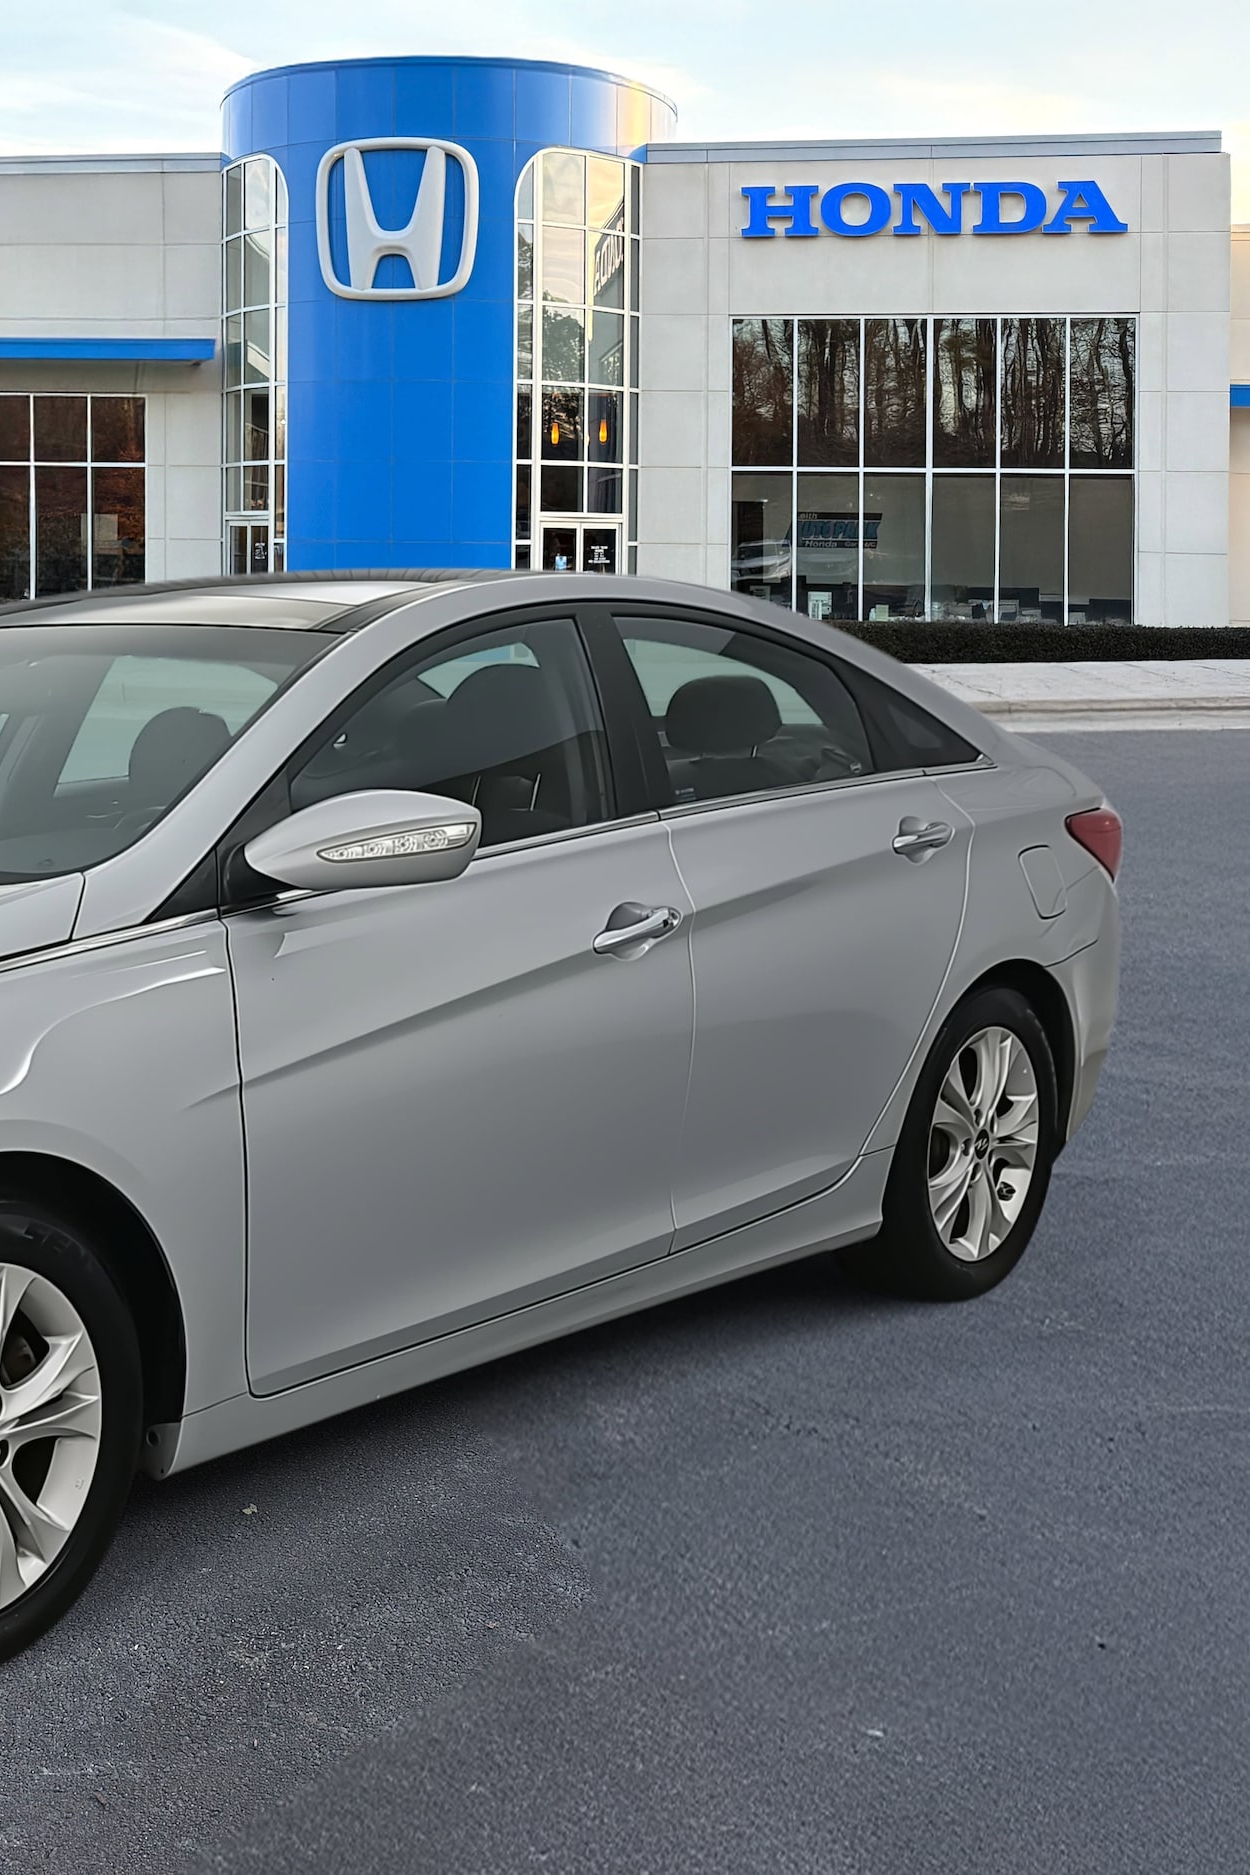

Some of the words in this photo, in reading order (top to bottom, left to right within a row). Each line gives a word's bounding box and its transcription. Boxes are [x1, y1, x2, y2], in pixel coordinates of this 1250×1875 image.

[740, 180, 1129, 238] HONDA
[797, 512, 818, 520] eith
[804, 540, 838, 548] Honda
